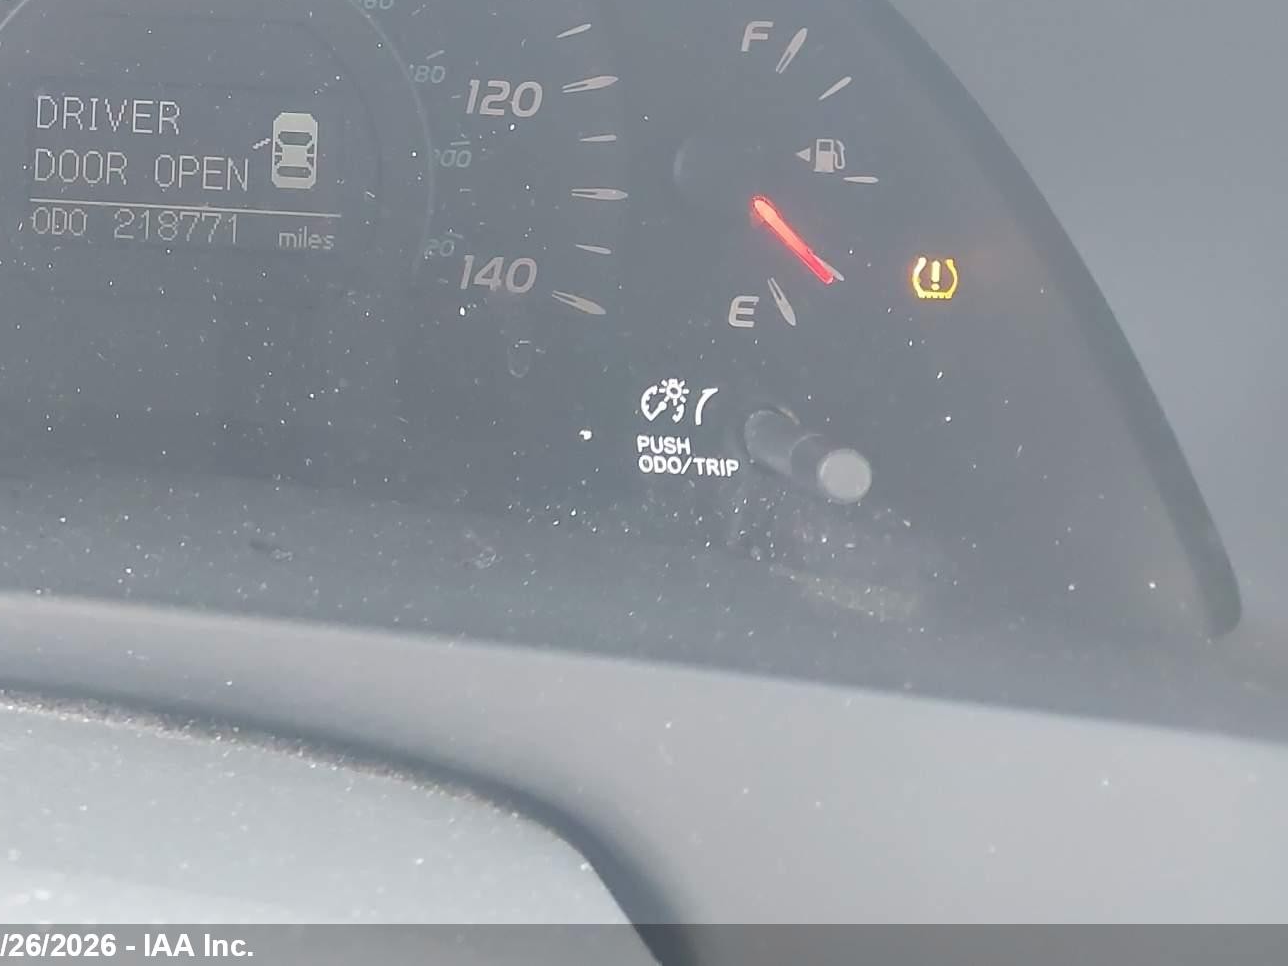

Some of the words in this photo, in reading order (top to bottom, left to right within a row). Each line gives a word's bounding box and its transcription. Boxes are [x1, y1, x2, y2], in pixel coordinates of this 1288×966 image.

[740, 20, 774, 52] F
[36, 95, 181, 135] DRIVER
[465, 80, 543, 118] 120
[34, 148, 128, 185] DOOR
[154, 153, 249, 192] OPEN
[31, 207, 88, 237] ODO
[113, 208, 238, 244] 218771
[278, 226, 335, 251] miles
[459, 255, 538, 296] 140
[728, 295, 760, 328] E
[636, 435, 691, 456] PUSH
[637, 456, 740, 478] ODO/TRIP
